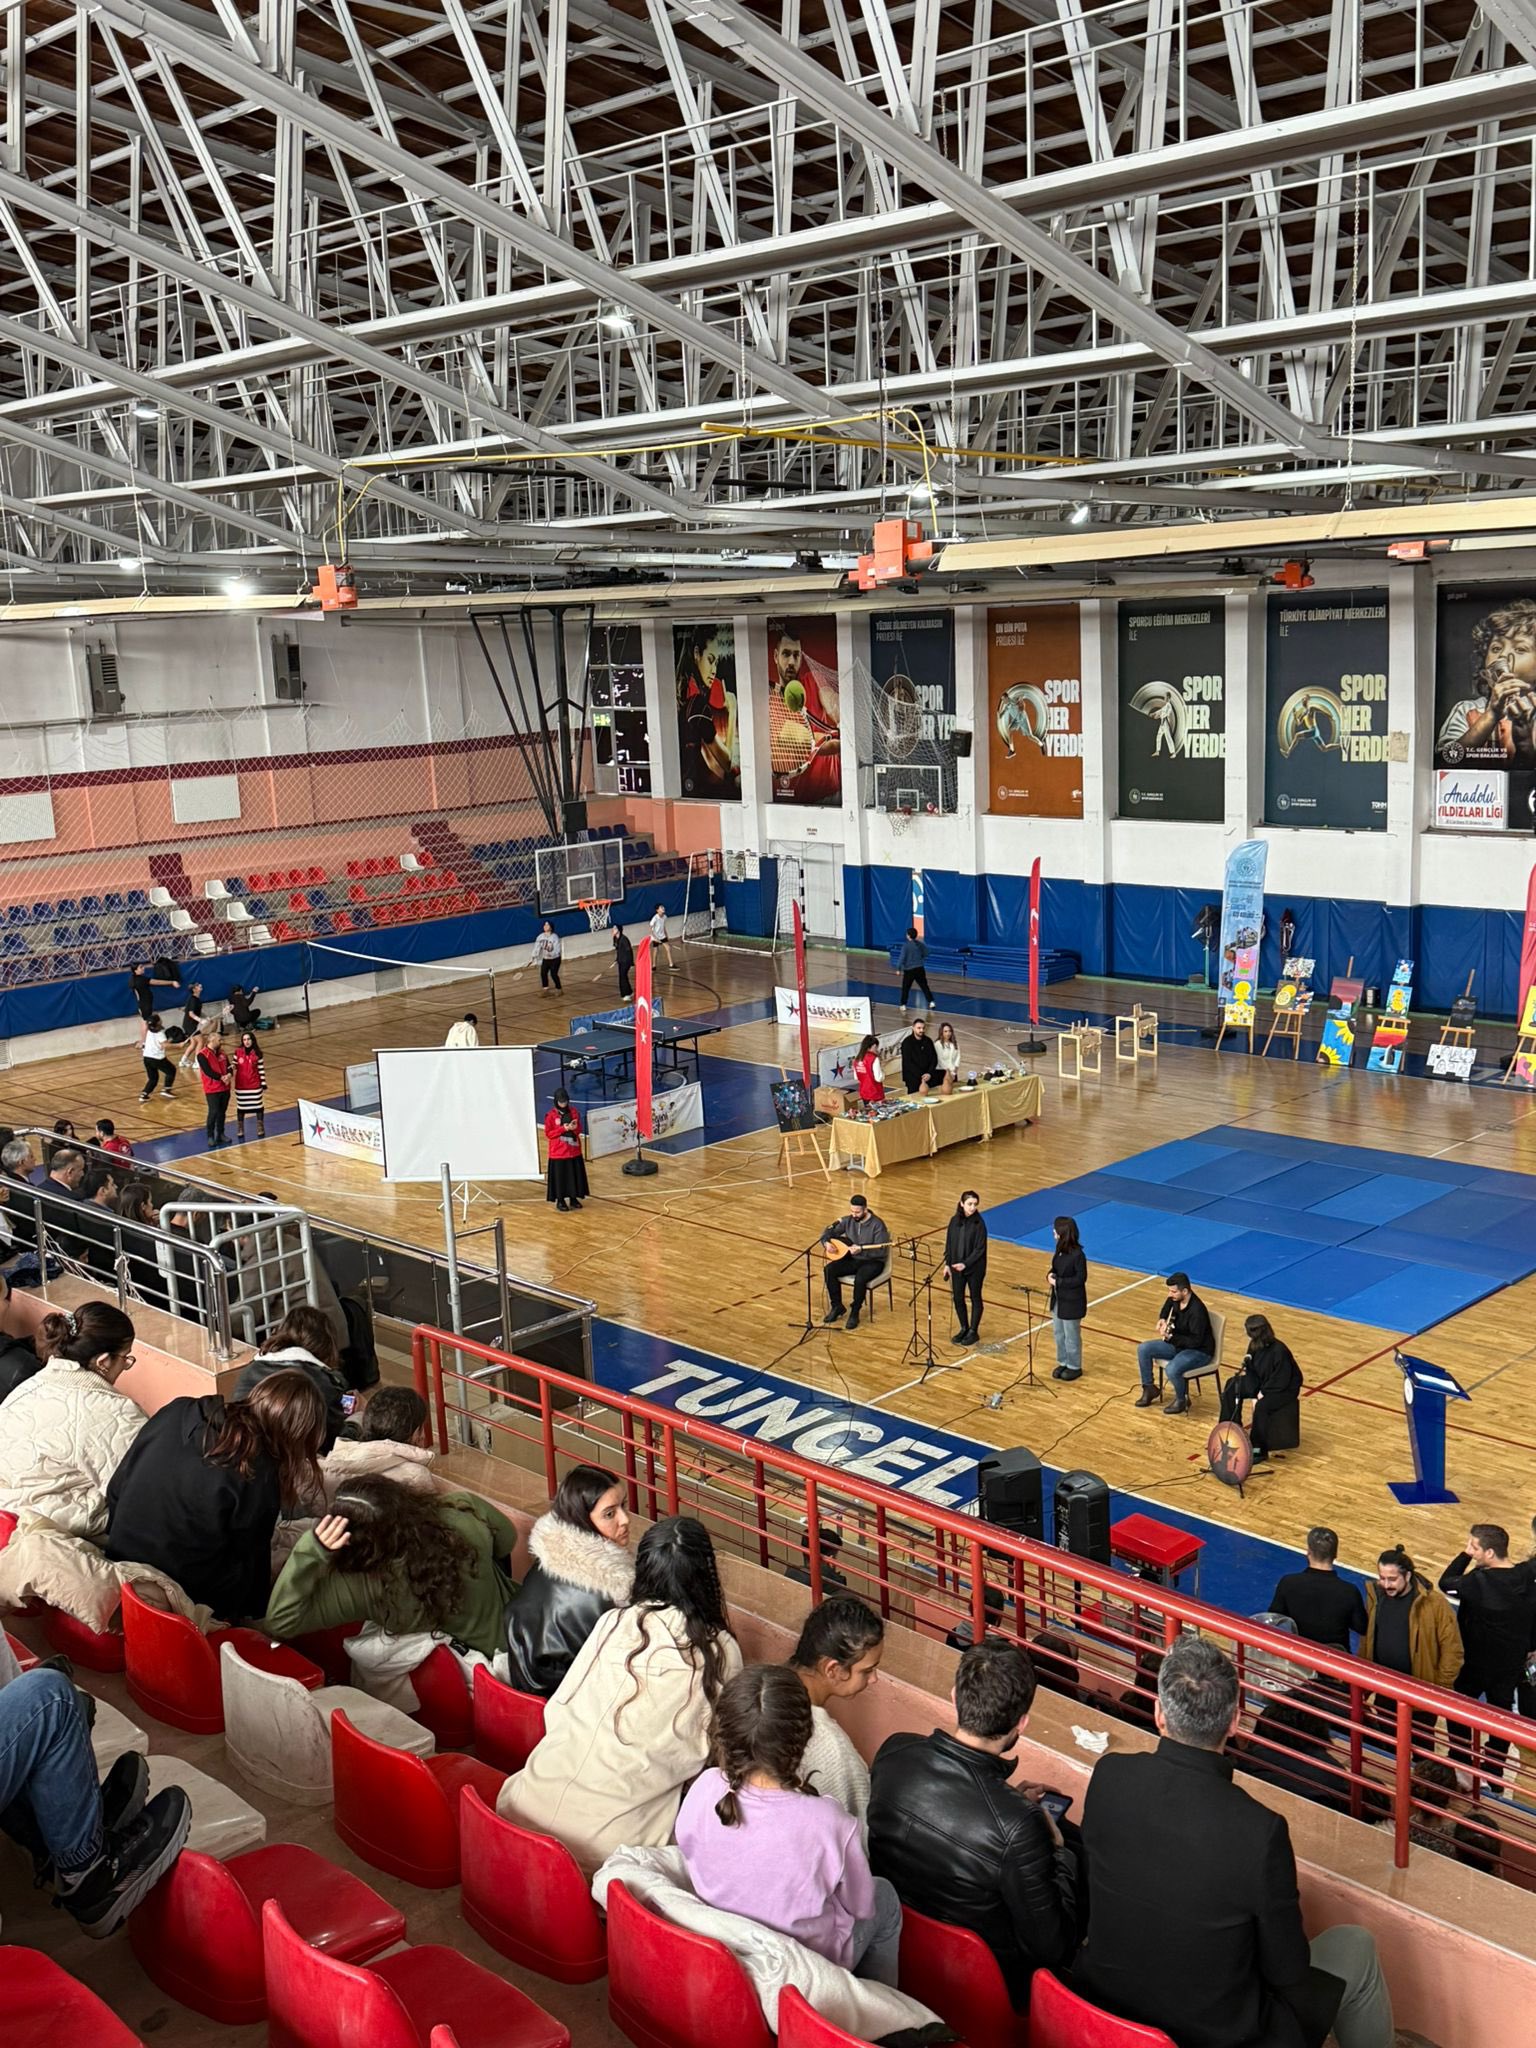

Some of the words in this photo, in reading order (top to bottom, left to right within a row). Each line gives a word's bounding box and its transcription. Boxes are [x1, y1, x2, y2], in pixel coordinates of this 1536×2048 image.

[1174, 610, 1211, 625] MERKEZLERİ
[1280, 608, 1307, 622] TÜRKİYE
[1308, 606, 1343, 621] OLİMPİYAT
[1343, 603, 1386, 620] MERKEZLERİ
[1129, 629, 1138, 641] İLE
[1280, 624, 1289, 637] İLE
[915, 684, 944, 711] SPOR
[1043, 679, 1081, 705] SPOR
[1182, 675, 1223, 702] SPOR
[1340, 674, 1388, 702] SPOR
[1184, 704, 1211, 730] HER
[1340, 705, 1373, 732] HER
[1045, 733, 1084, 759] YERDE
[1183, 733, 1227, 759] YERDE
[1339, 735, 1391, 762] YERDE
[1443, 782, 1496, 804] Anadolu
[1486, 804, 1504, 819] LİGİ
[807, 1004, 861, 1020] ÜRKİYE
[323, 1120, 381, 1148] TÜRKİYE
[629, 1359, 981, 1517] TUNCEL
